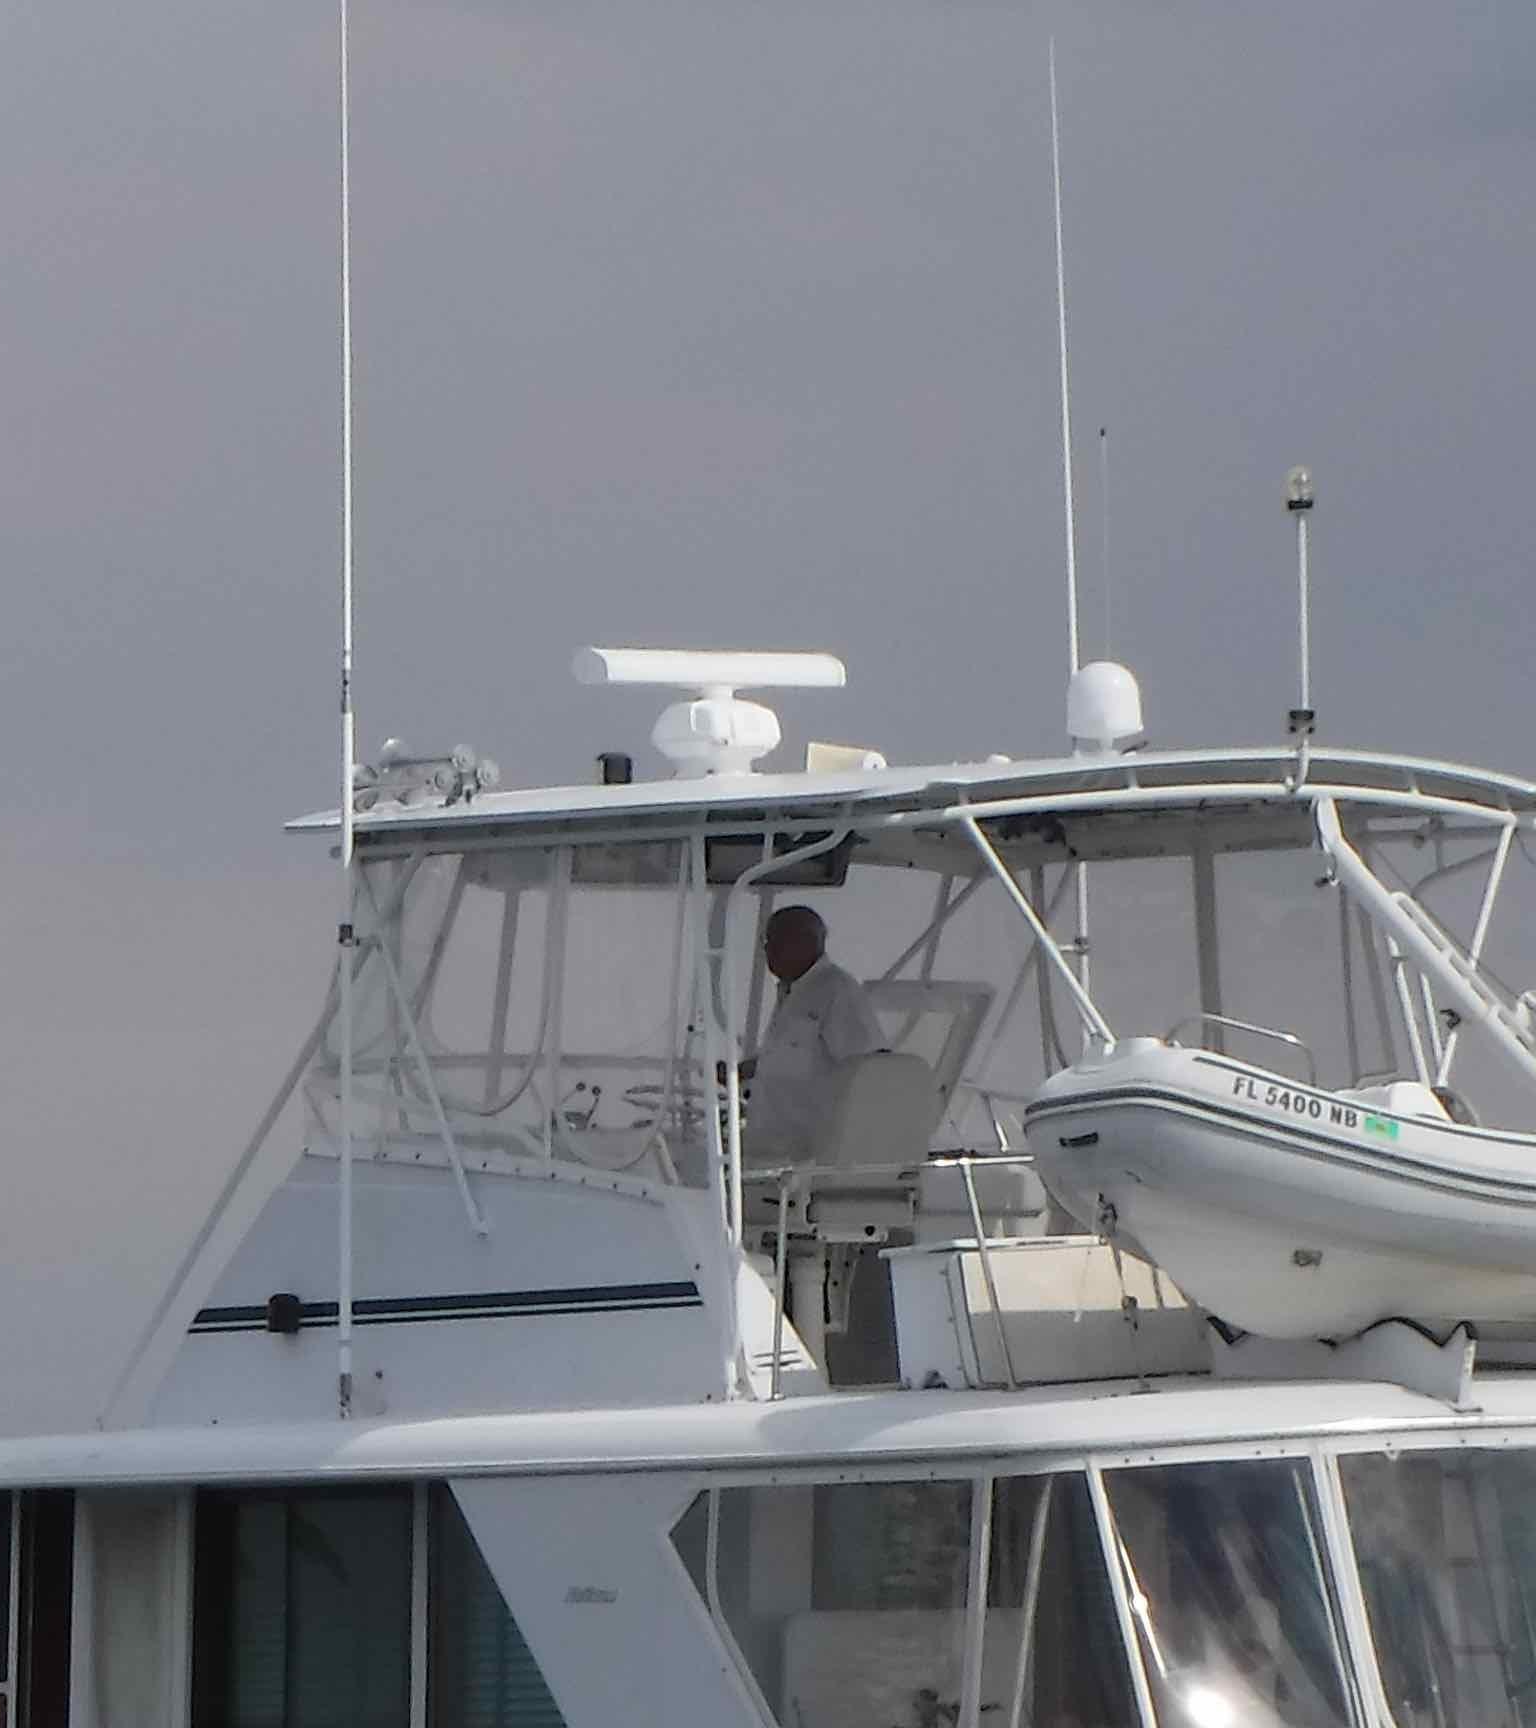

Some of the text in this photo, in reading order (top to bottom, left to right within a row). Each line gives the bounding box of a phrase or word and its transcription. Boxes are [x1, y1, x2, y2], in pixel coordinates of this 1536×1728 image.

[1233, 1077, 1358, 1128] FL 5400 NB
